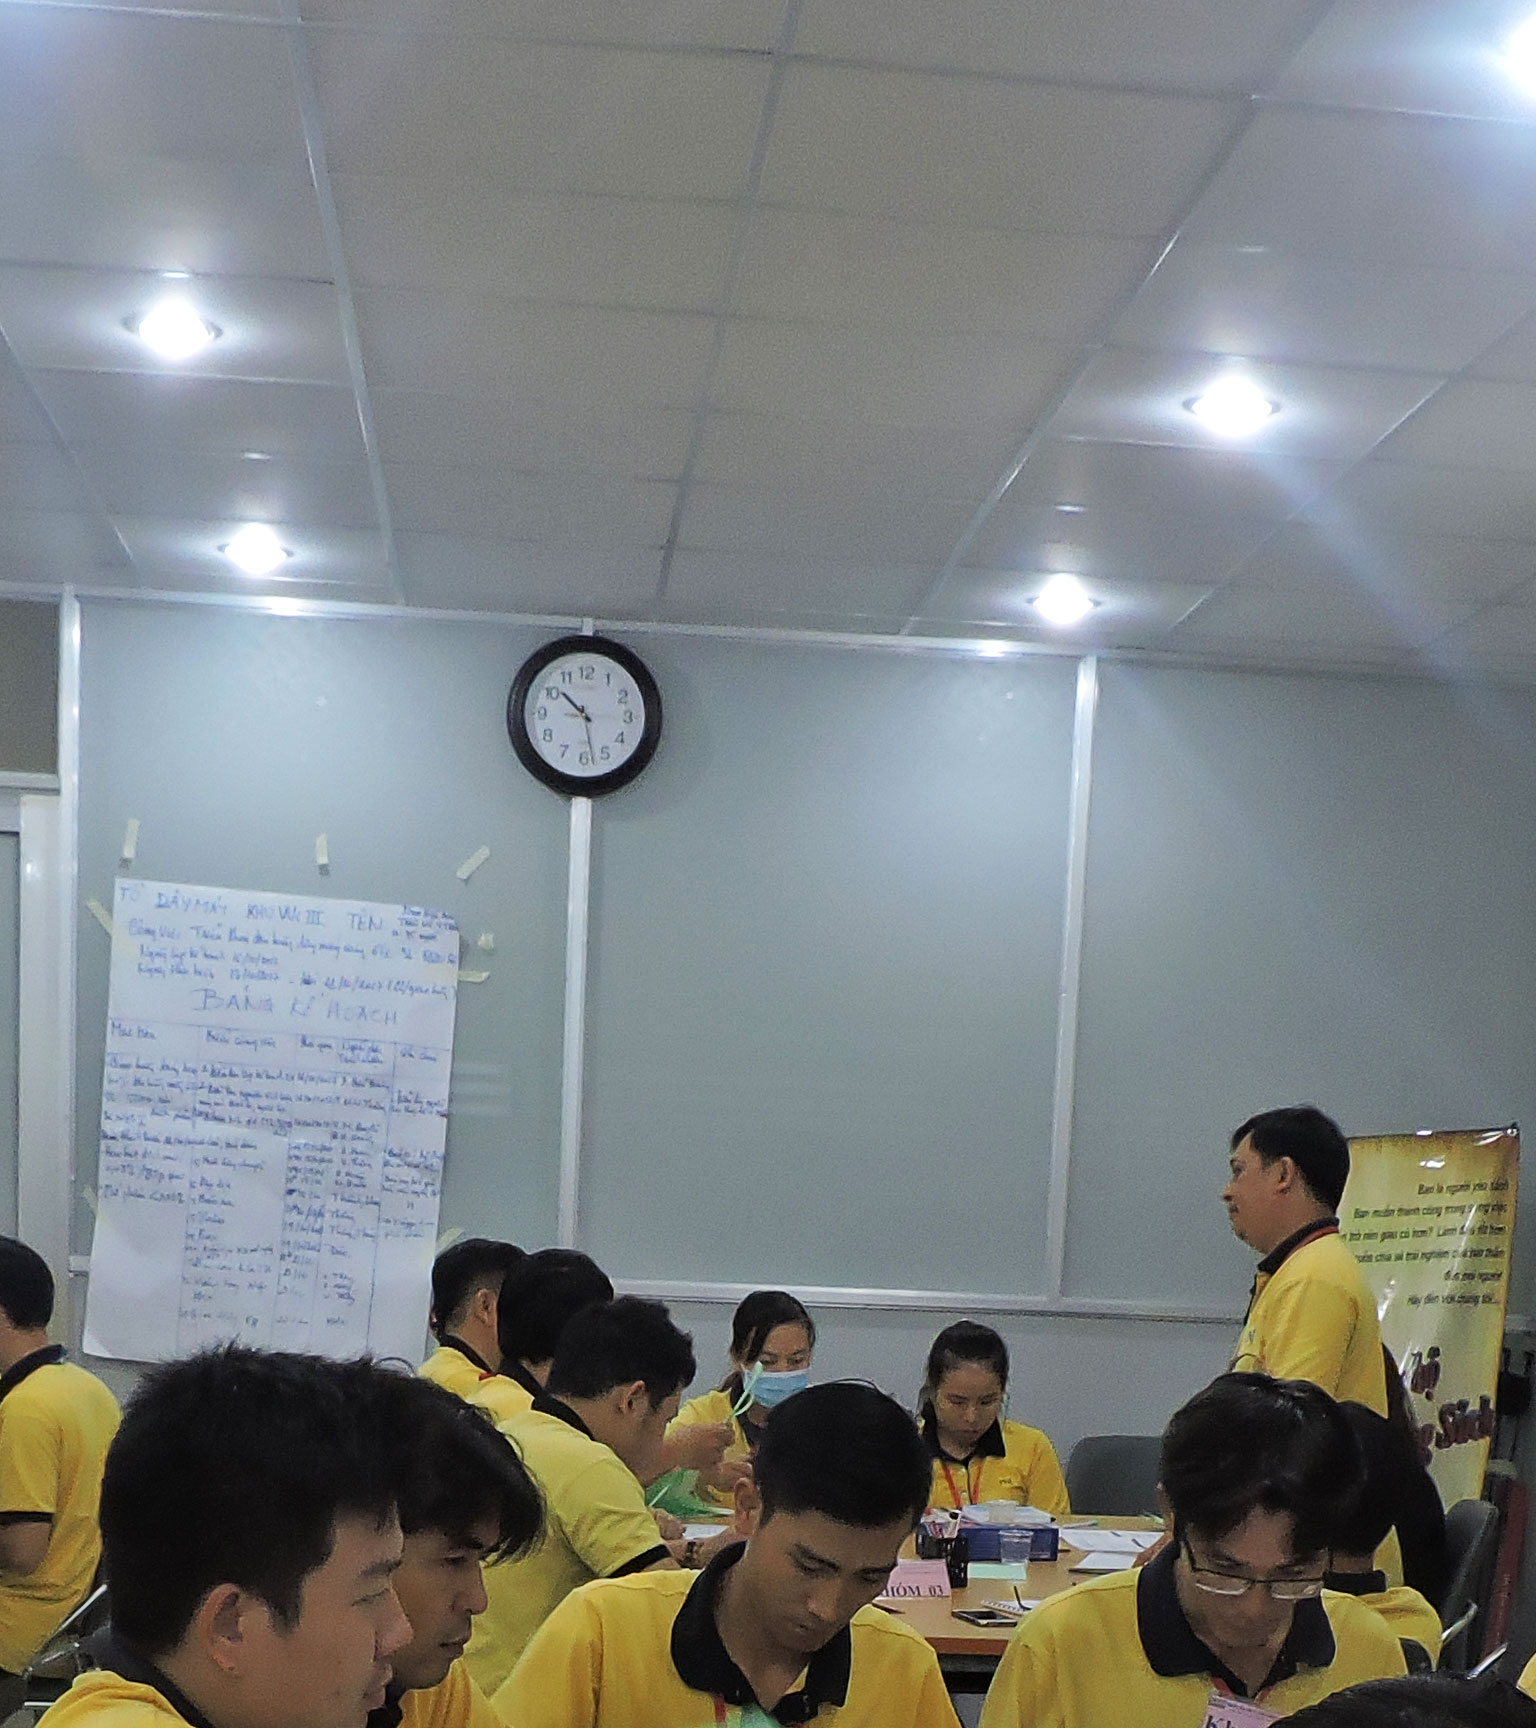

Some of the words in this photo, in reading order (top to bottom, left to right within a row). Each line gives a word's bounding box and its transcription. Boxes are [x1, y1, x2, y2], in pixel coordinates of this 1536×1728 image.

[560, 671, 572, 684] 11
[578, 665, 595, 680] 12
[605, 672, 611, 686] 1
[544, 686, 560, 700] 10
[617, 689, 628, 704] 2
[537, 706, 547, 720] 9
[623, 710, 634, 724] 3
[542, 728, 553, 743] 8
[614, 731, 625, 744] 4
[559, 743, 569, 759] 7
[578, 751, 589, 765] 6
[600, 745, 610, 760] 5
[880, 1582, 921, 1597] HÓM
[928, 1584, 944, 1597] 03
